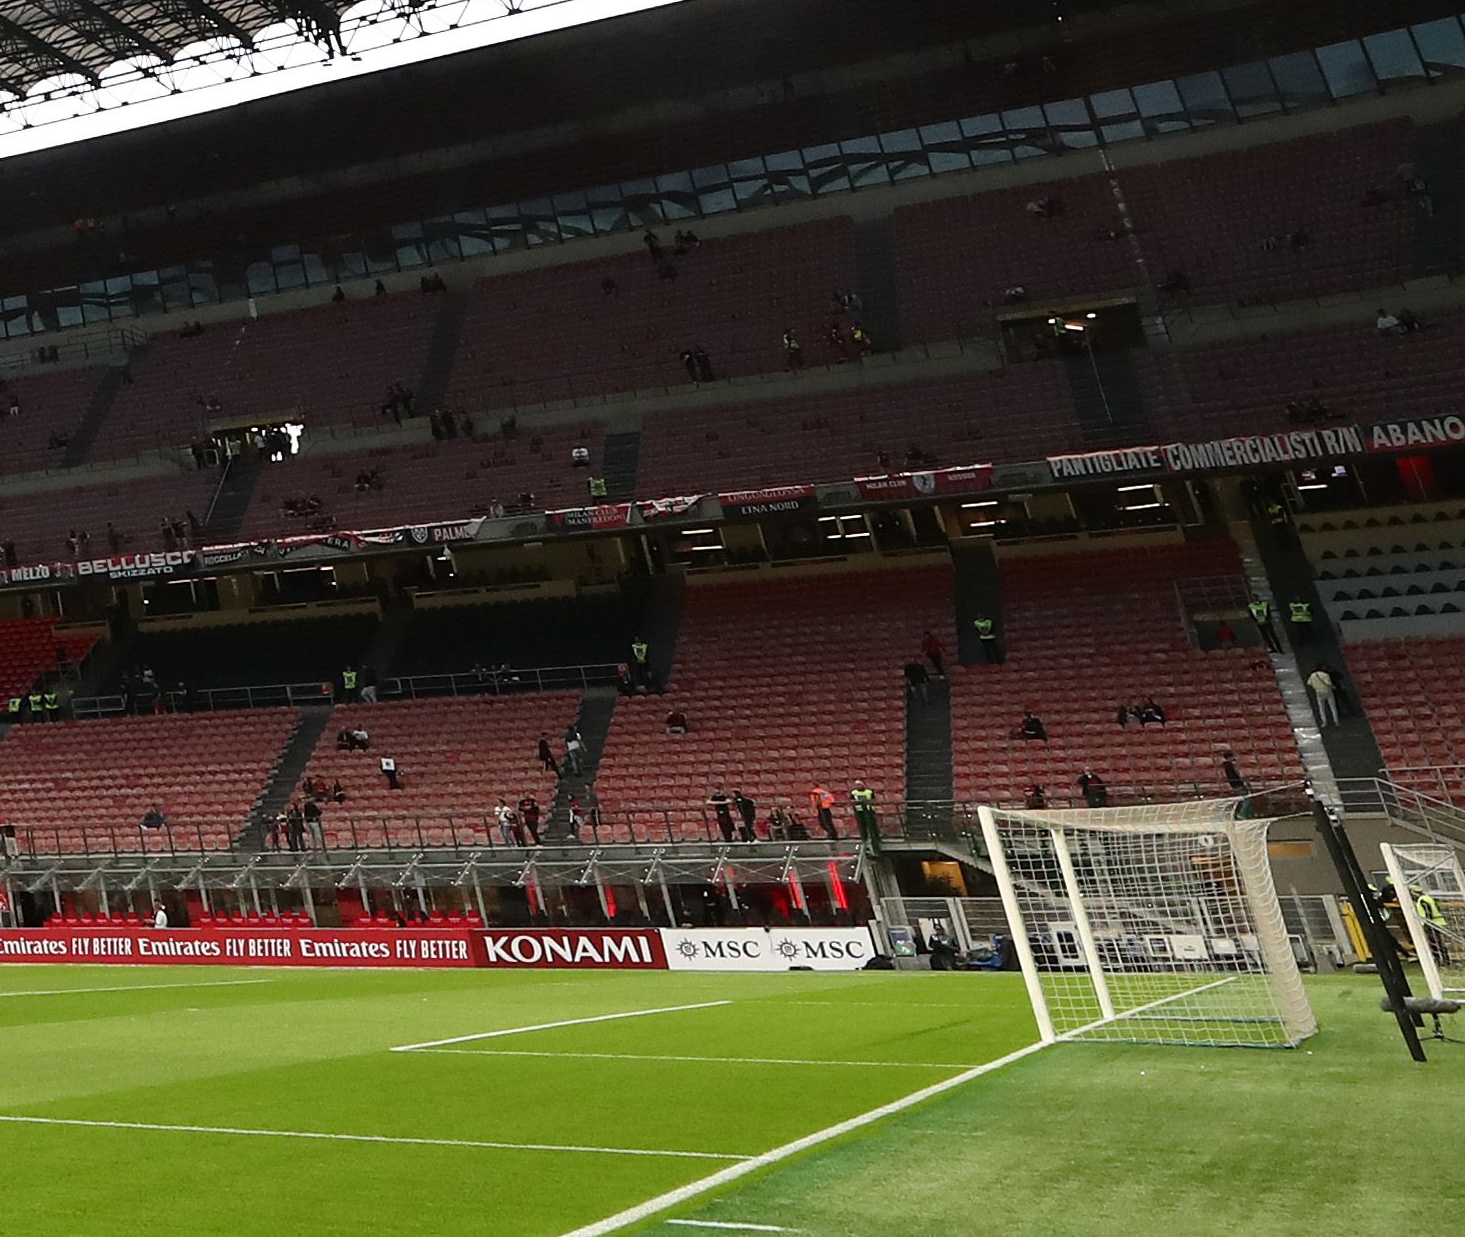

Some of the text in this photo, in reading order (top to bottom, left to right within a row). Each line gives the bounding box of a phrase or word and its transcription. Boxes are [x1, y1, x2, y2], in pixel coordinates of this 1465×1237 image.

[1372, 416, 1465, 449] ABANO
[1169, 424, 1363, 471] COMMERCIALISTI R/N
[1050, 449, 1162, 477] PANTIGLIATE
[769, 500, 799, 512] NORD
[11, 565, 50, 583] MELZO
[109, 566, 173, 579] SKIZZATO
[72, 937, 89, 955] FLY
[92, 937, 132, 956] BETTER
[137, 937, 292, 958] Emirates FLY BETTER
[299, 939, 468, 960] Emirates FLY BETTER
[483, 935, 653, 963] KONAMI
[702, 940, 761, 959] MSC
[803, 940, 865, 960] MSC
